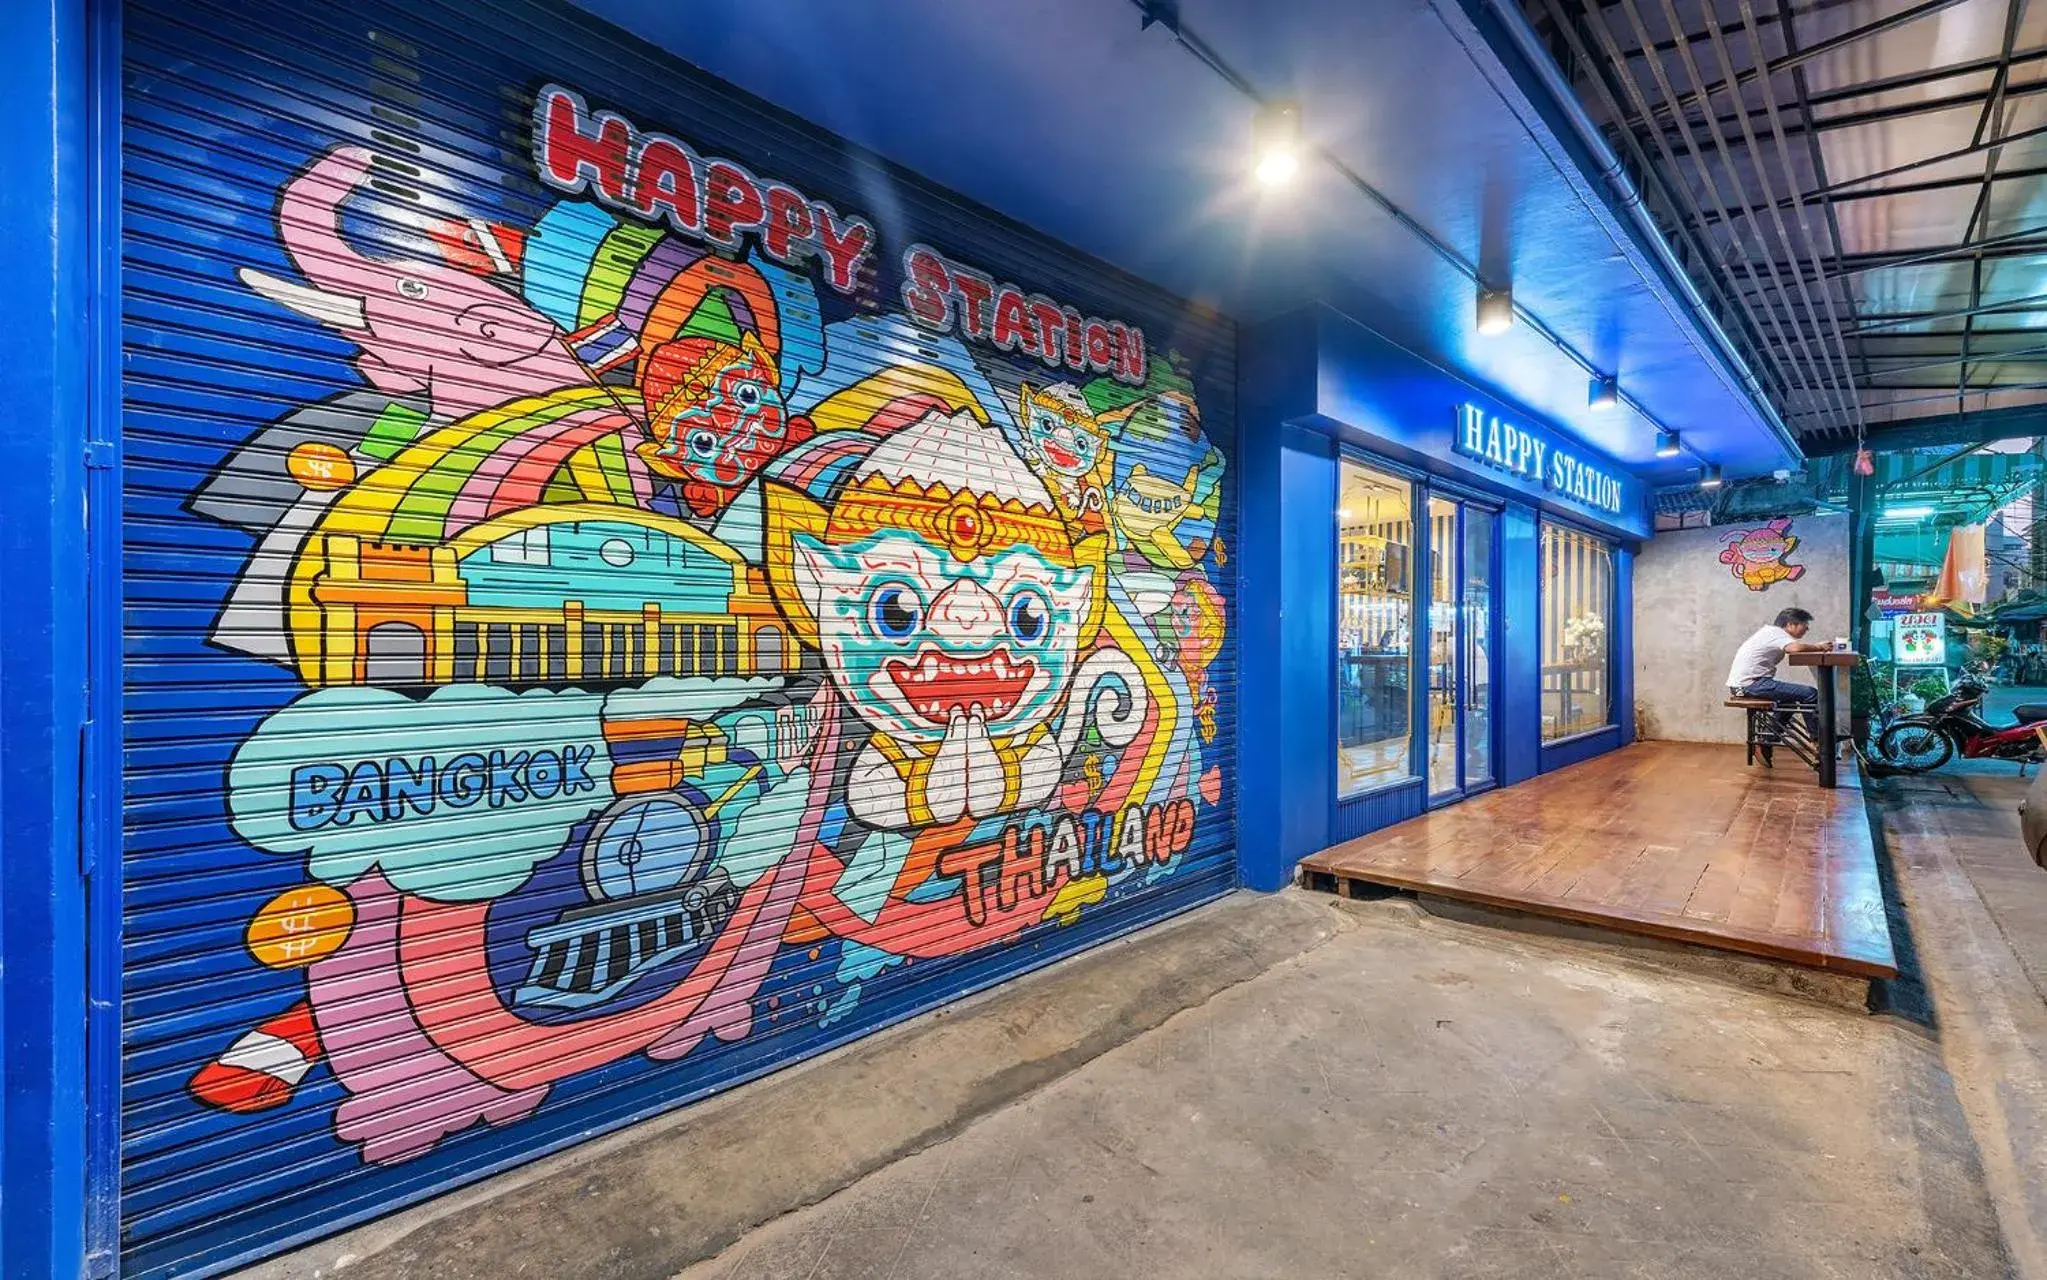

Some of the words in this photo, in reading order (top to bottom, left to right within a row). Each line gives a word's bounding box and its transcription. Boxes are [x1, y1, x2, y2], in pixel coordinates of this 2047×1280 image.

[537, 85, 873, 293] HAPPY
[903, 246, 1145, 382] STATION
[1463, 402, 1547, 481] HAPPY
[1553, 451, 1621, 513] STATION
[289, 744, 596, 831] BANGKOK
[936, 799, 1196, 928] THAILAND
